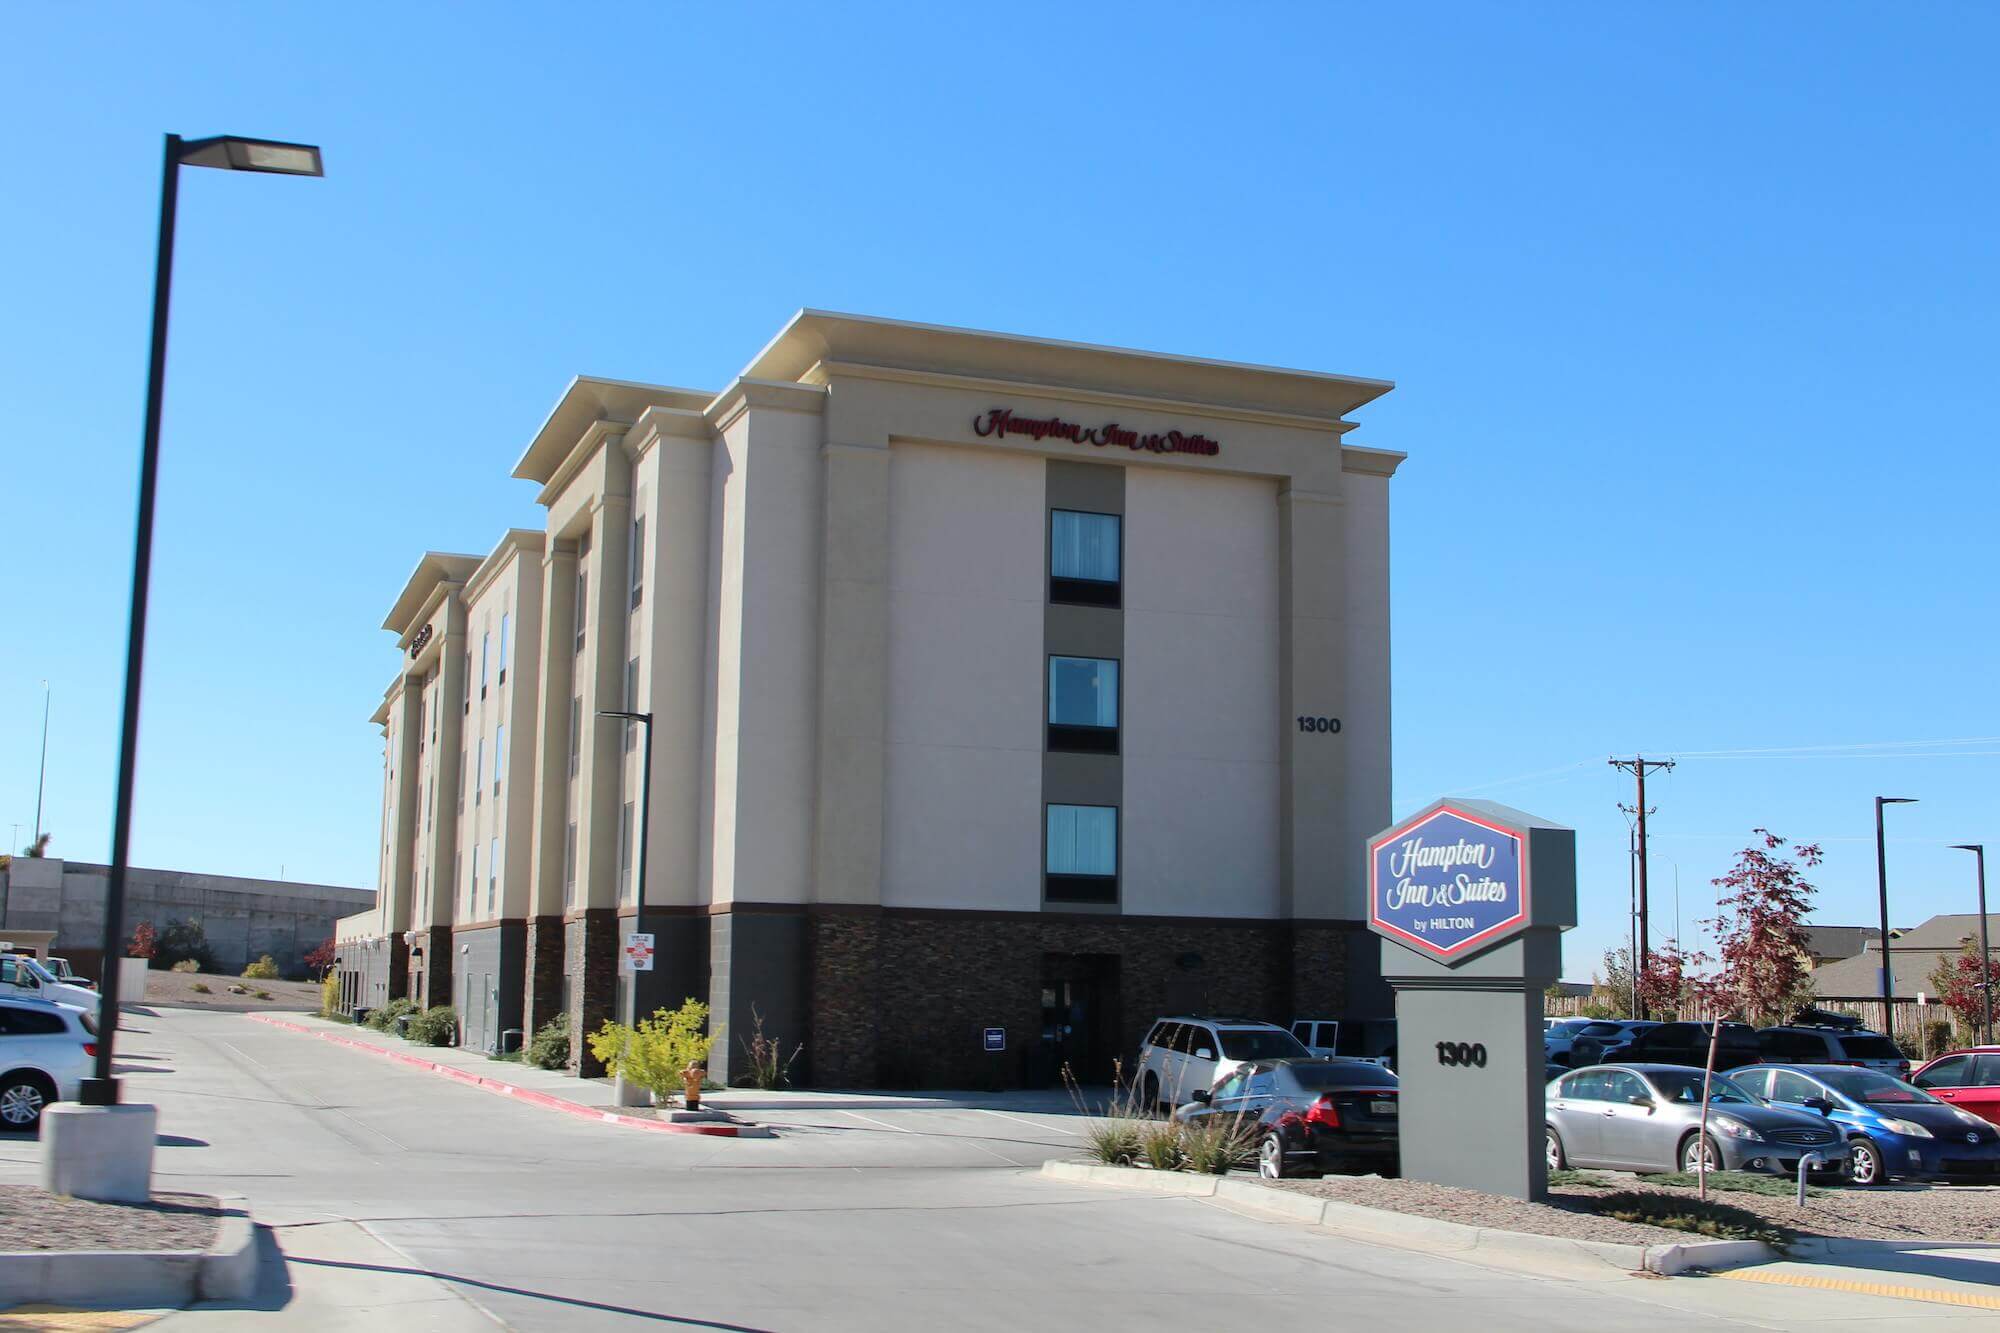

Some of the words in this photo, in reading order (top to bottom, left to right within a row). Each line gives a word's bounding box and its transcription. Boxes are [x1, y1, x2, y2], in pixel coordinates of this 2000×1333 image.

[973, 408, 1091, 444] Hampton
[1090, 423, 1147, 451] Inn
[1161, 430, 1219, 455] Suites
[1297, 716, 1341, 734] 1300
[1390, 837, 1495, 877] Hampton
[1386, 876, 1437, 910] Inn
[1449, 873, 1507, 905] Suites
[1414, 918, 1427, 932] by
[1430, 917, 1475, 930] HILTON
[1435, 1041, 1487, 1068] 1300
